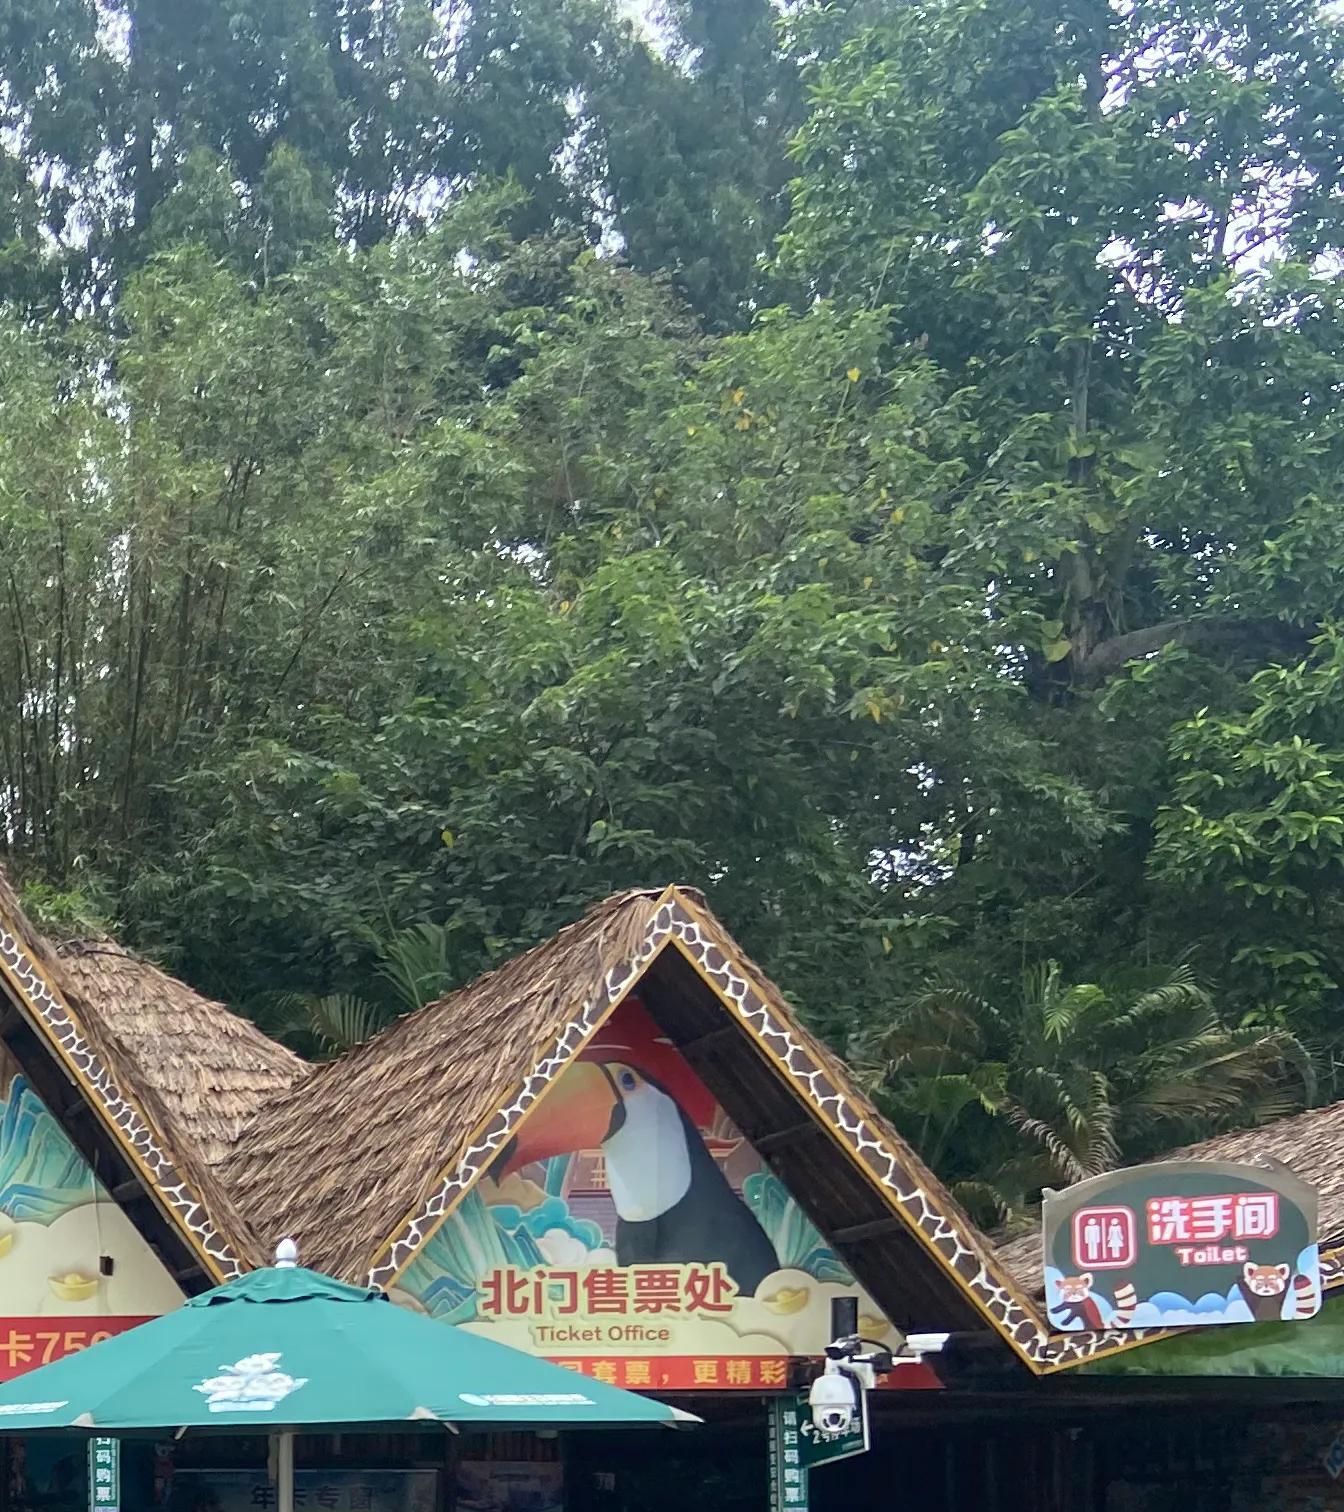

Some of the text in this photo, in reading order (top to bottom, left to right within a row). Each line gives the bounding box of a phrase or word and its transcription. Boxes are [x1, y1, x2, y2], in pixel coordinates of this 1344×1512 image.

[1150, 1194, 1275, 1241] 洗手间
[481, 1268, 735, 1316] 北门售票处
[535, 1324, 670, 1342] Ticket Office
